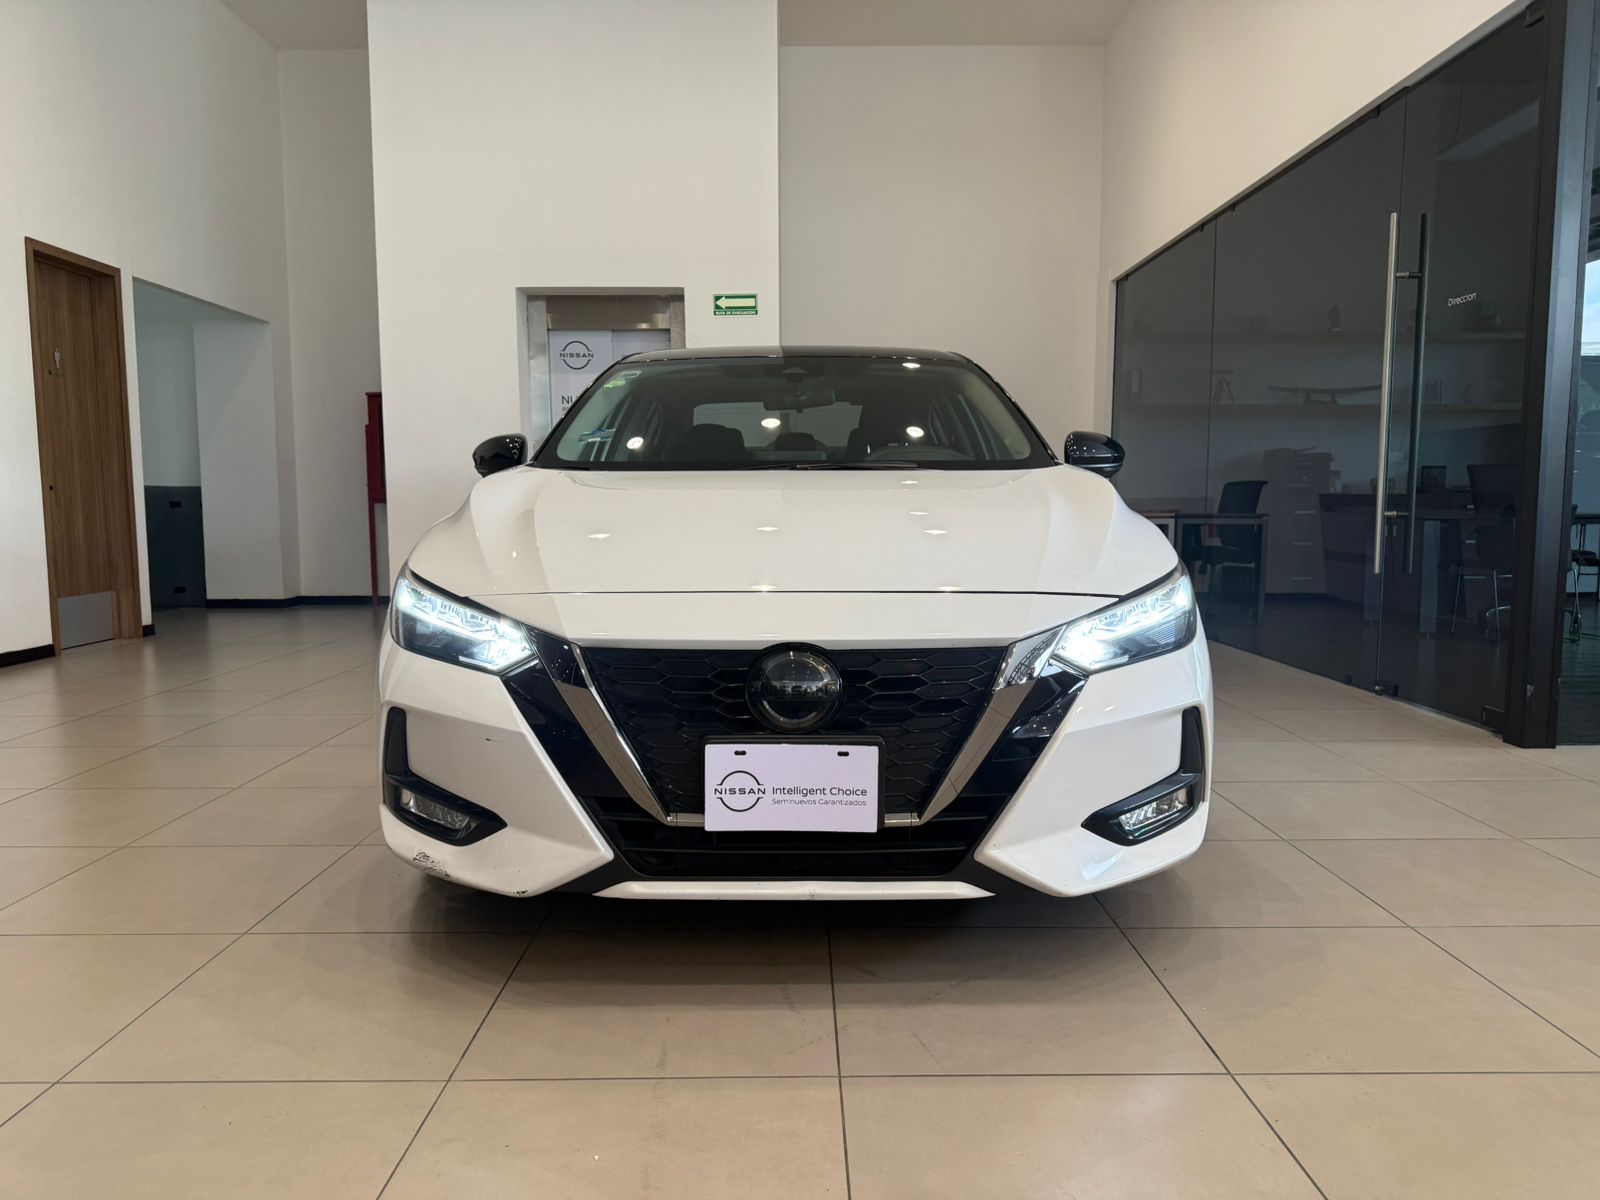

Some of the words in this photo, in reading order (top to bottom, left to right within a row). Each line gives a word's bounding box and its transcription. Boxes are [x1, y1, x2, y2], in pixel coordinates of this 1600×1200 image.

[772, 786, 827, 797] Intelligent
[829, 786, 868, 797] Choice
[771, 798, 817, 806] Seminuevos
[818, 798, 867, 807] Garantizados
